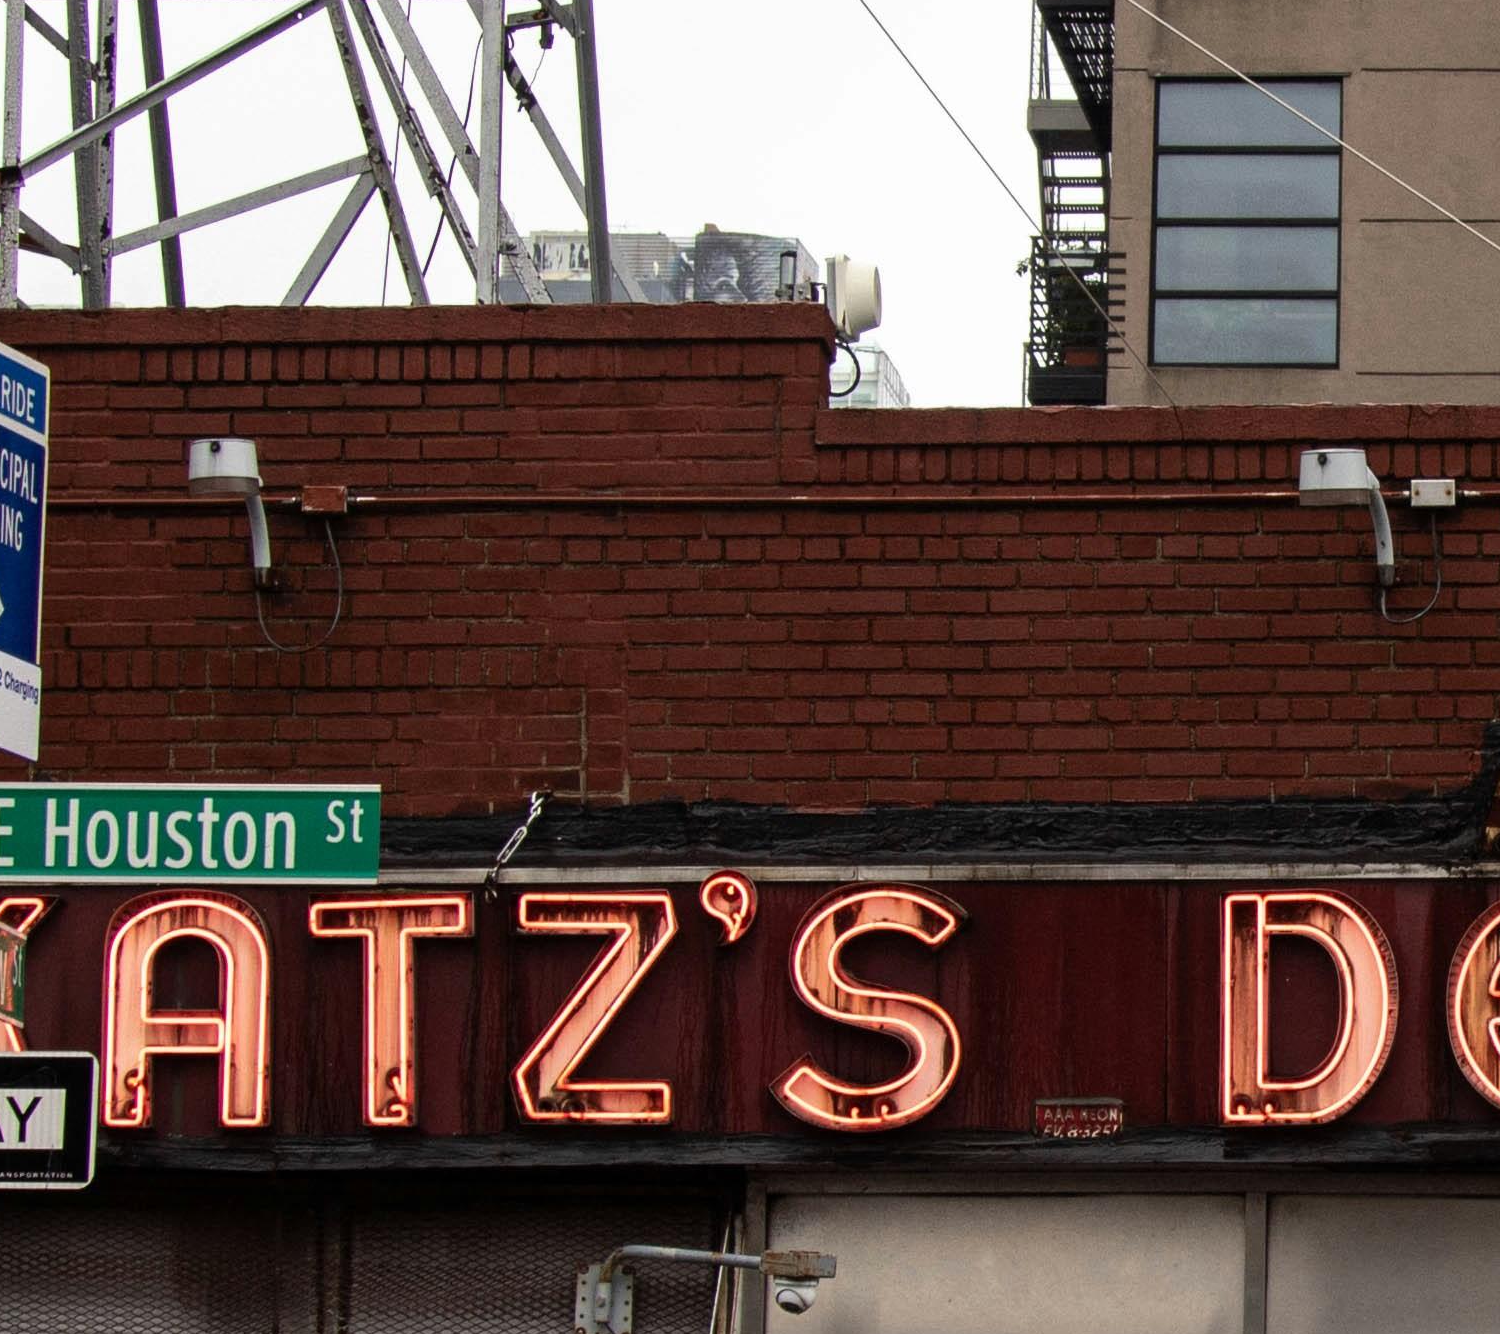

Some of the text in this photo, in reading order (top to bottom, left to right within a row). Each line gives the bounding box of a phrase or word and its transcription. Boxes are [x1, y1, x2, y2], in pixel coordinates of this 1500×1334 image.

[1, 375, 36, 424] RIDE
[4, 673, 39, 705] Charging
[45, 798, 296, 869] Houston
[327, 800, 364, 844] St
